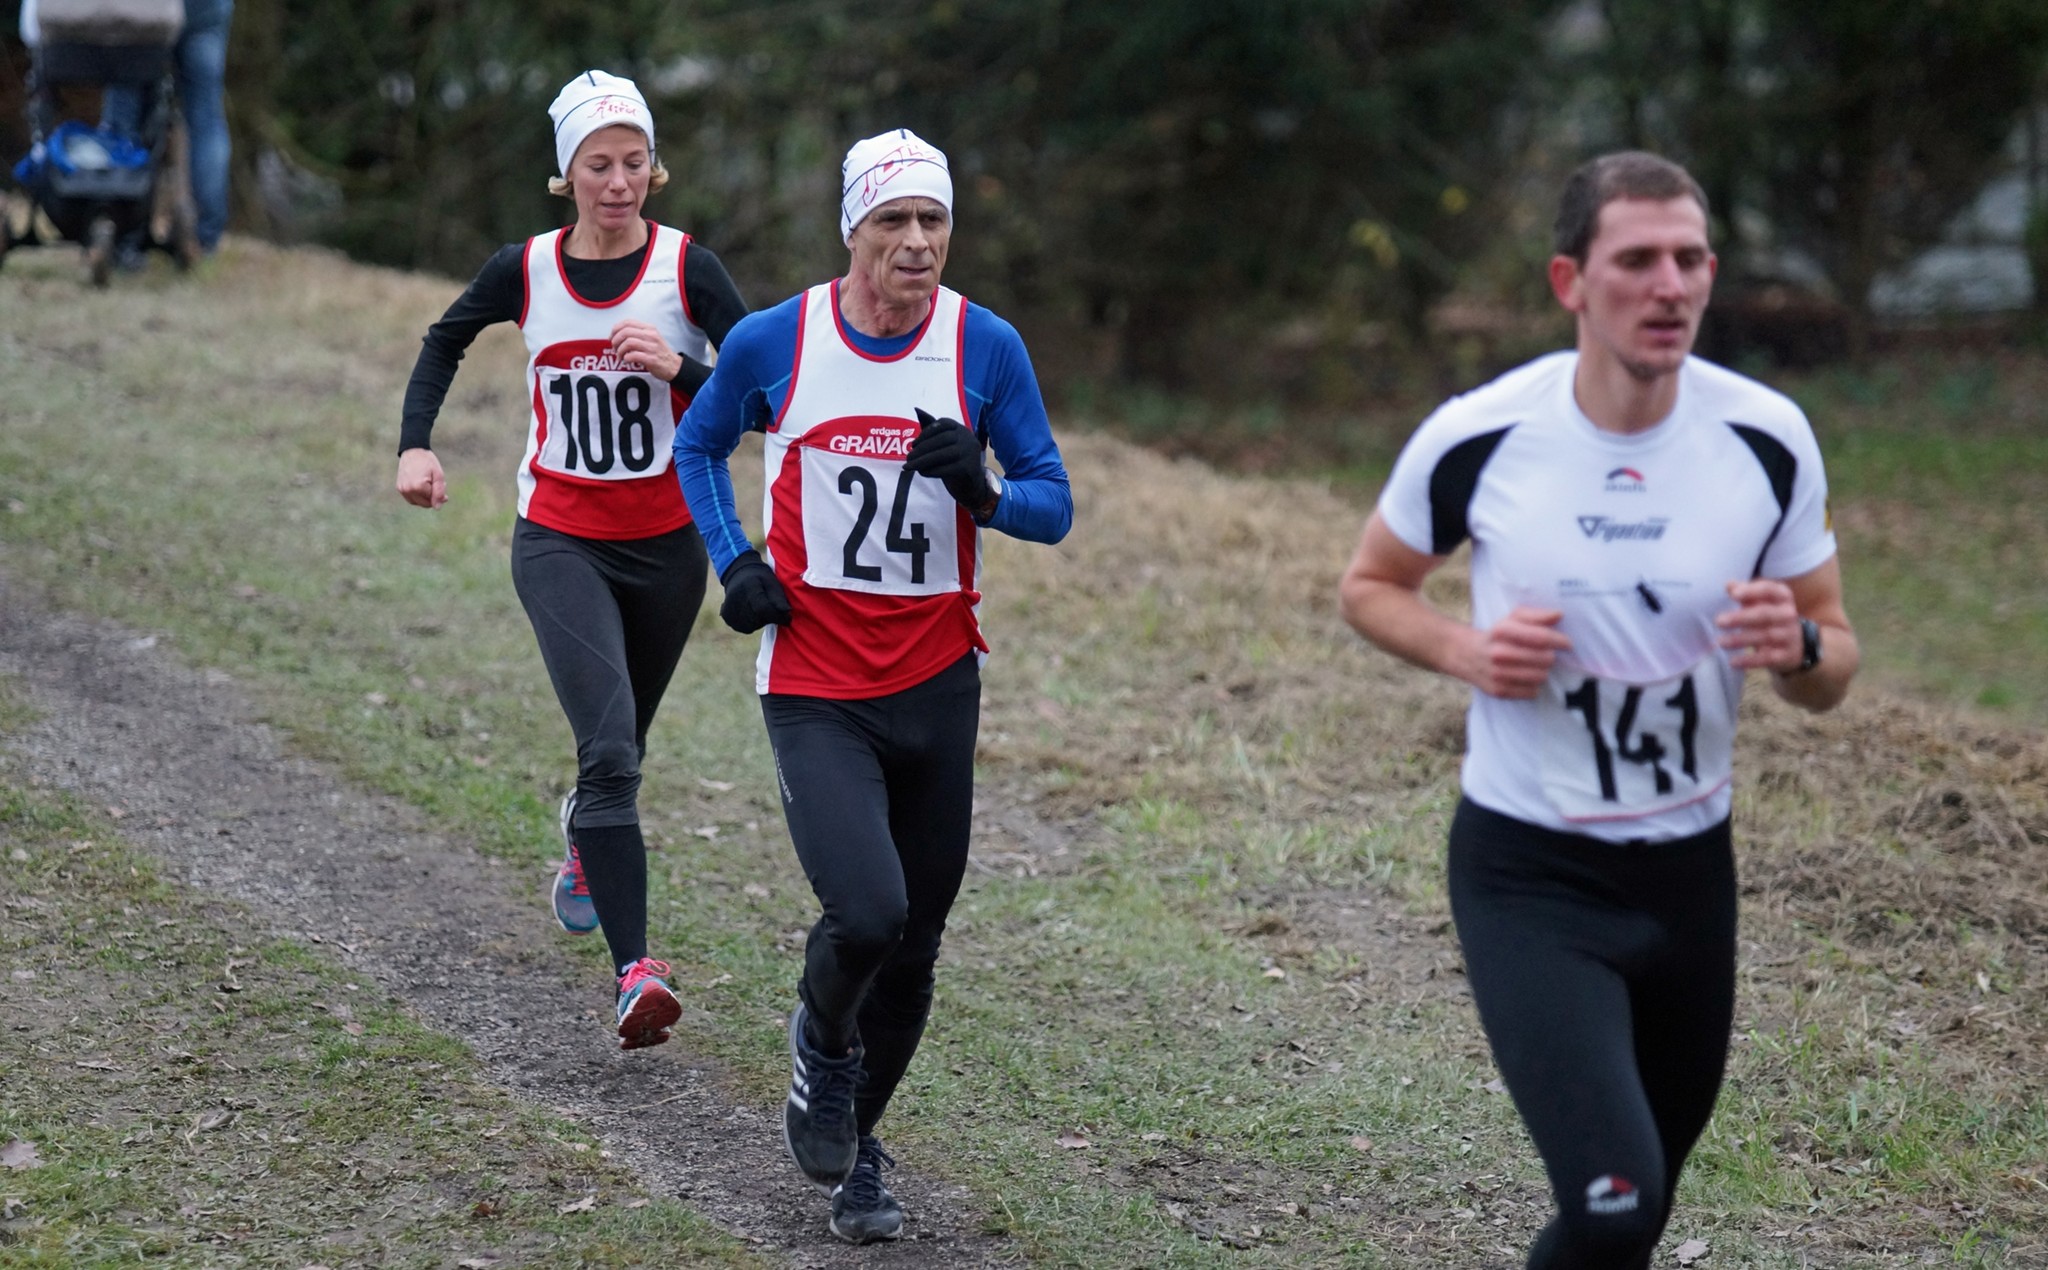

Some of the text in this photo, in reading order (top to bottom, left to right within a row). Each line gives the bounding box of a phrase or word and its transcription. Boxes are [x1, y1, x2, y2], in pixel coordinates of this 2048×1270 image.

[549, 374, 655, 475] 108
[870, 427, 901, 437] erdgas
[838, 465, 930, 584] 24
[1565, 674, 1699, 802] 141
